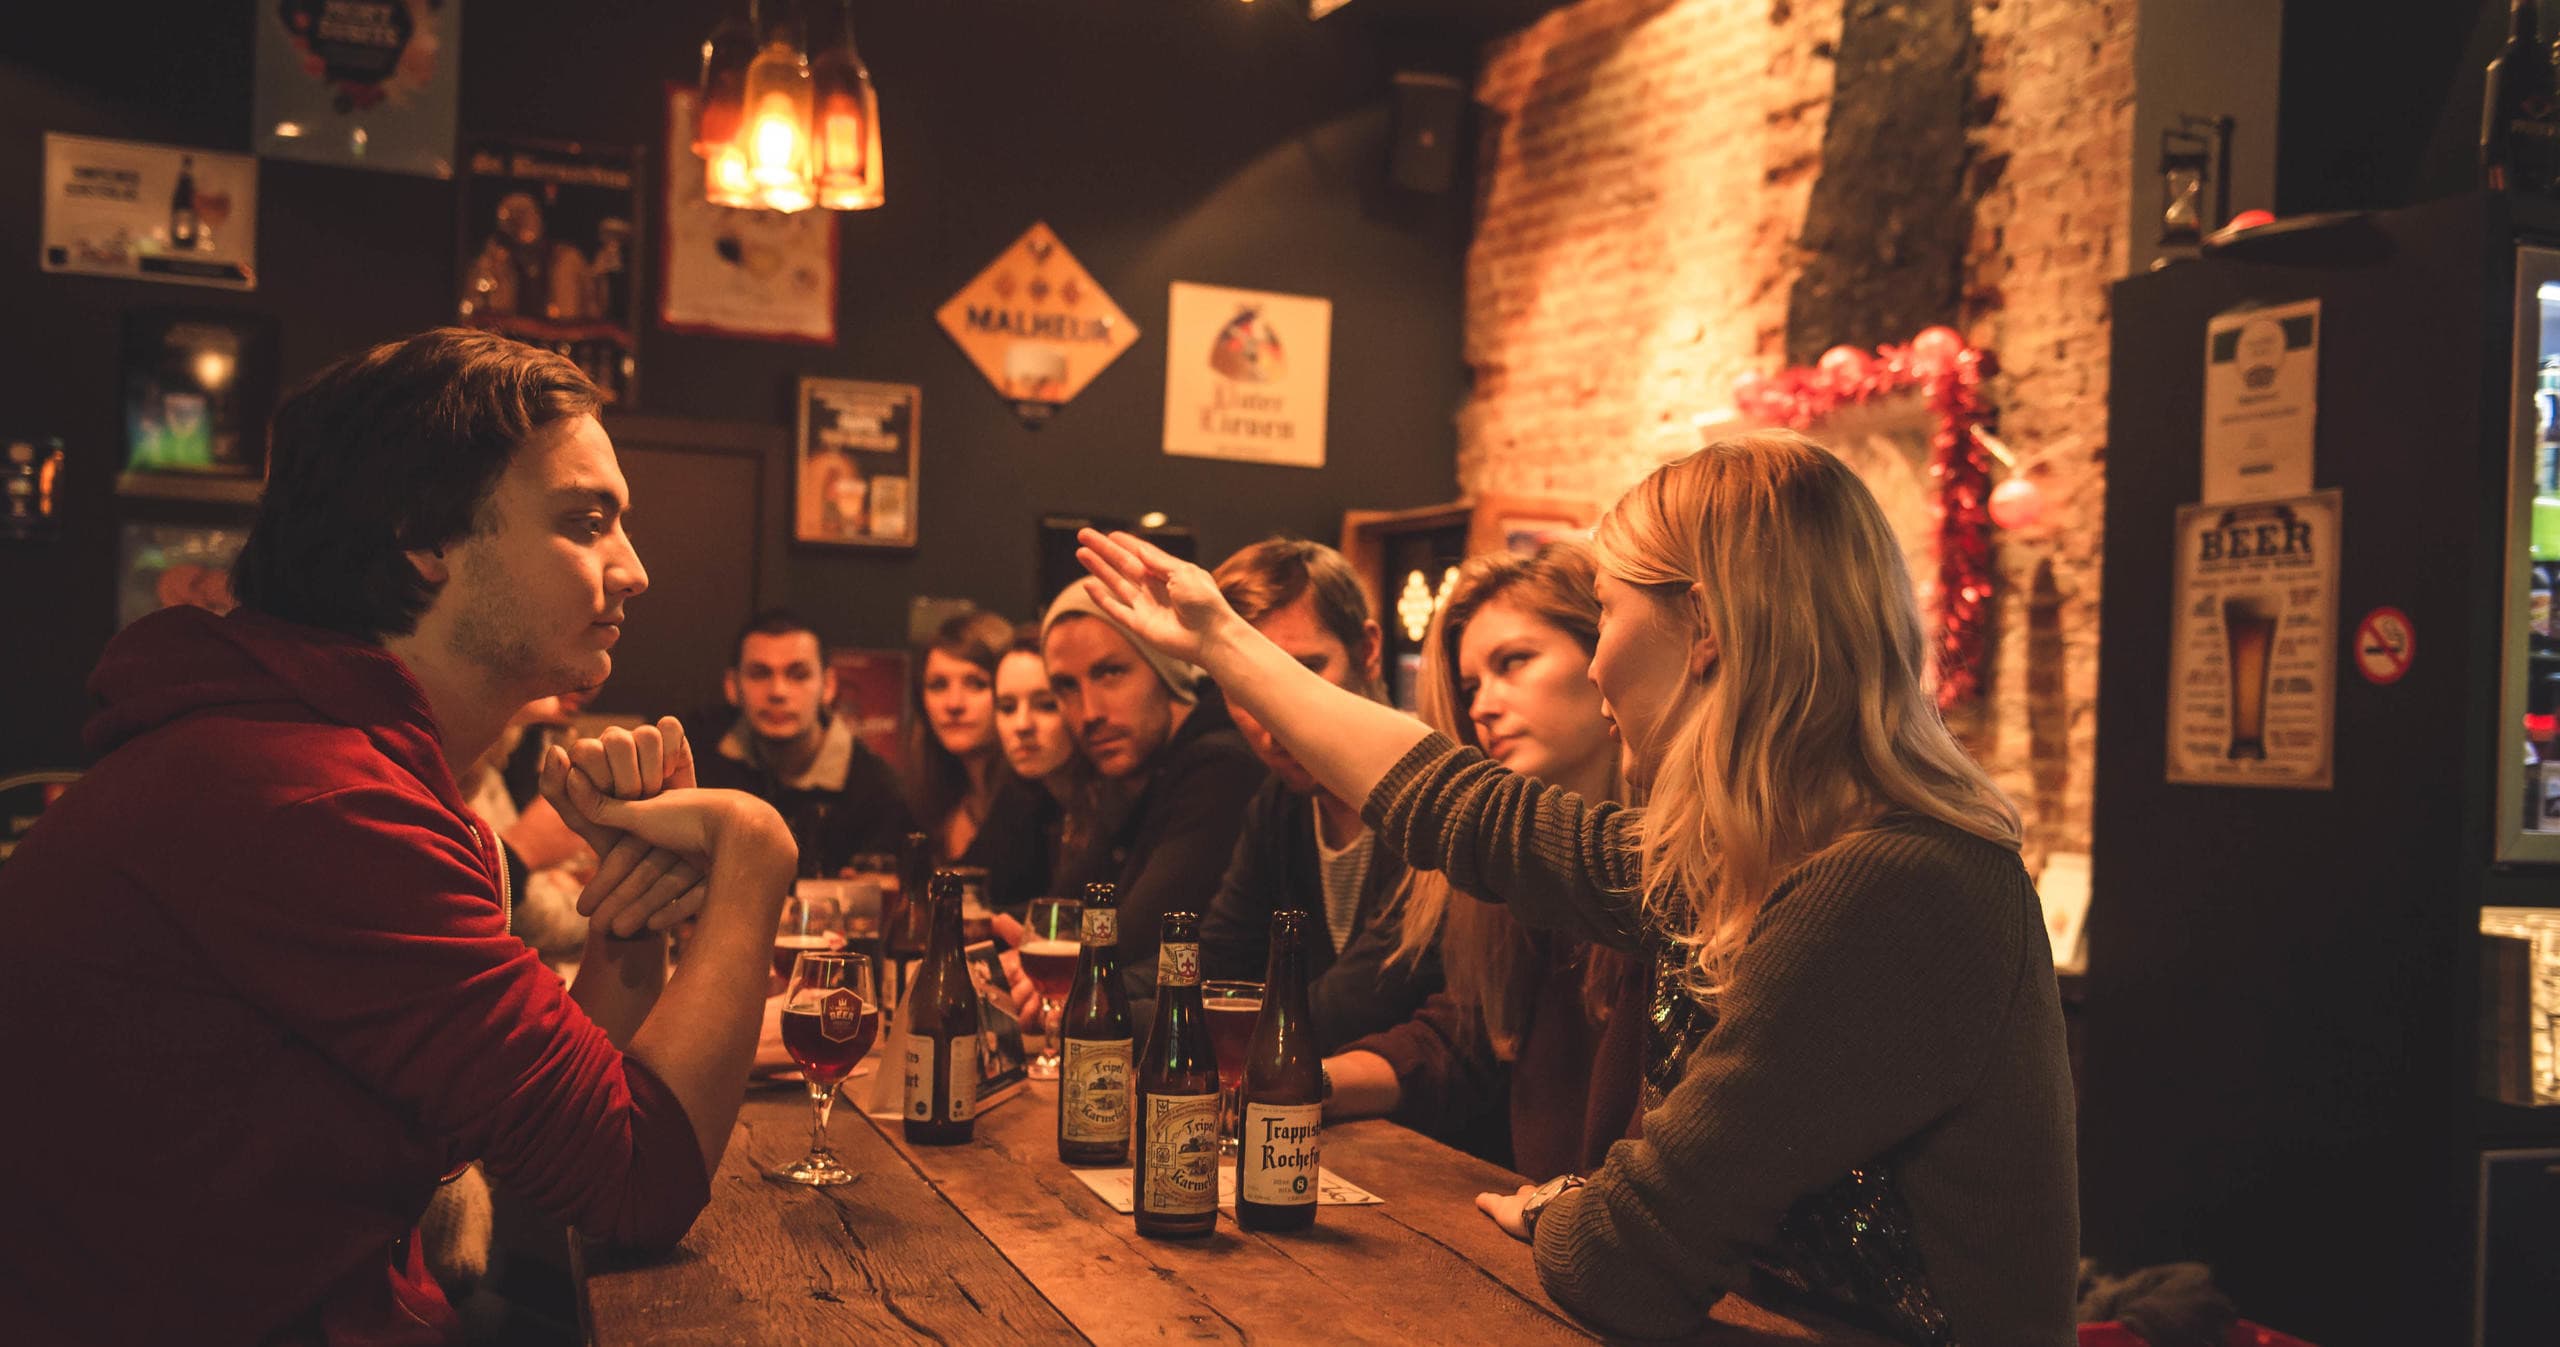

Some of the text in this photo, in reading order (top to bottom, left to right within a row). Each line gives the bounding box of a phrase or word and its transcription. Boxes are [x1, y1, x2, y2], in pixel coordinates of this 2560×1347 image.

[966, 304, 1113, 344] MALHEUR
[2200, 521, 2312, 561] BEER
[1093, 1060, 1125, 1074] Tripel
[1182, 1118, 1215, 1136] Tripel
